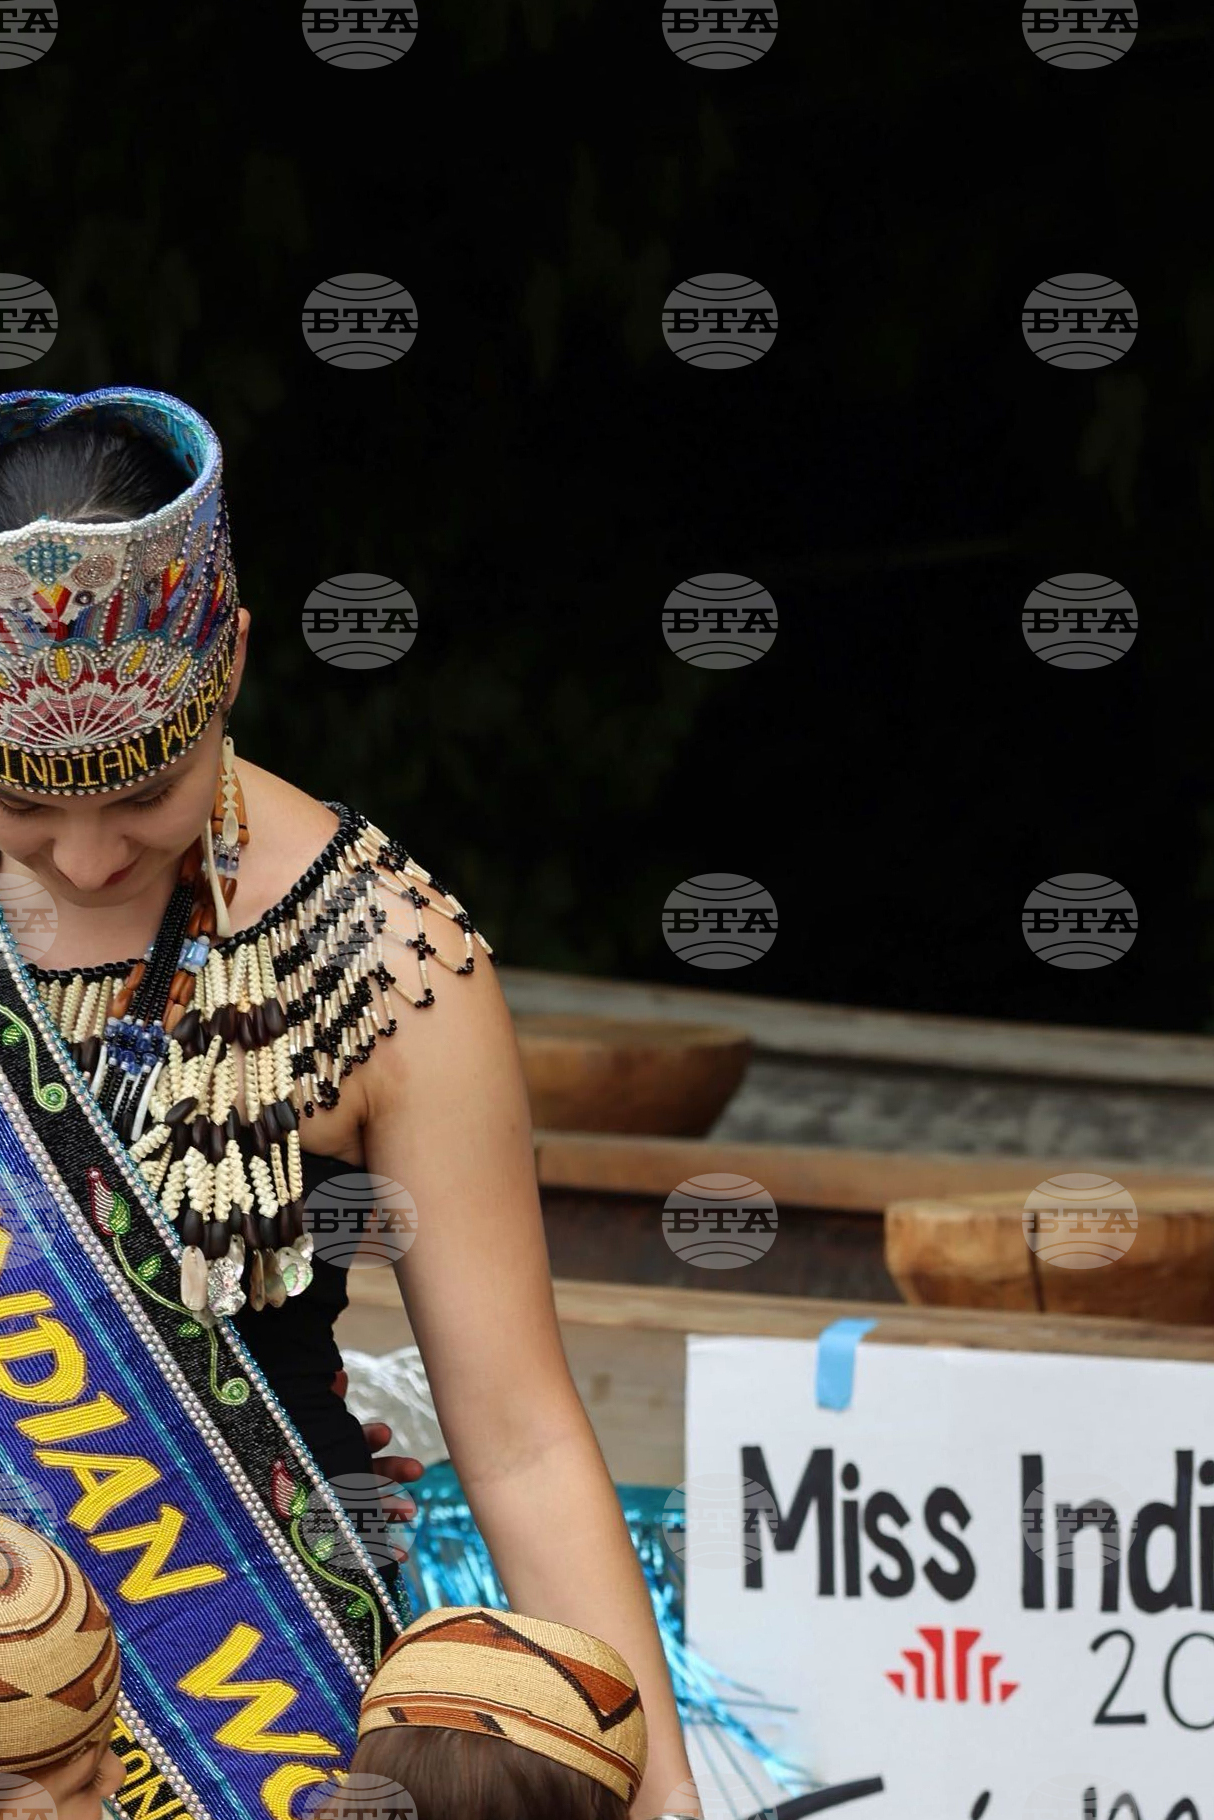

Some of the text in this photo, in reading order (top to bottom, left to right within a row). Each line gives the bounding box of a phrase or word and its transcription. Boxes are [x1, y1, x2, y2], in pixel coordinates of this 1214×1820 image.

[0, 738, 150, 788] INDIAN
[159, 643, 232, 763] WORLD
[739, 1445, 1214, 1615] Miss Indi
